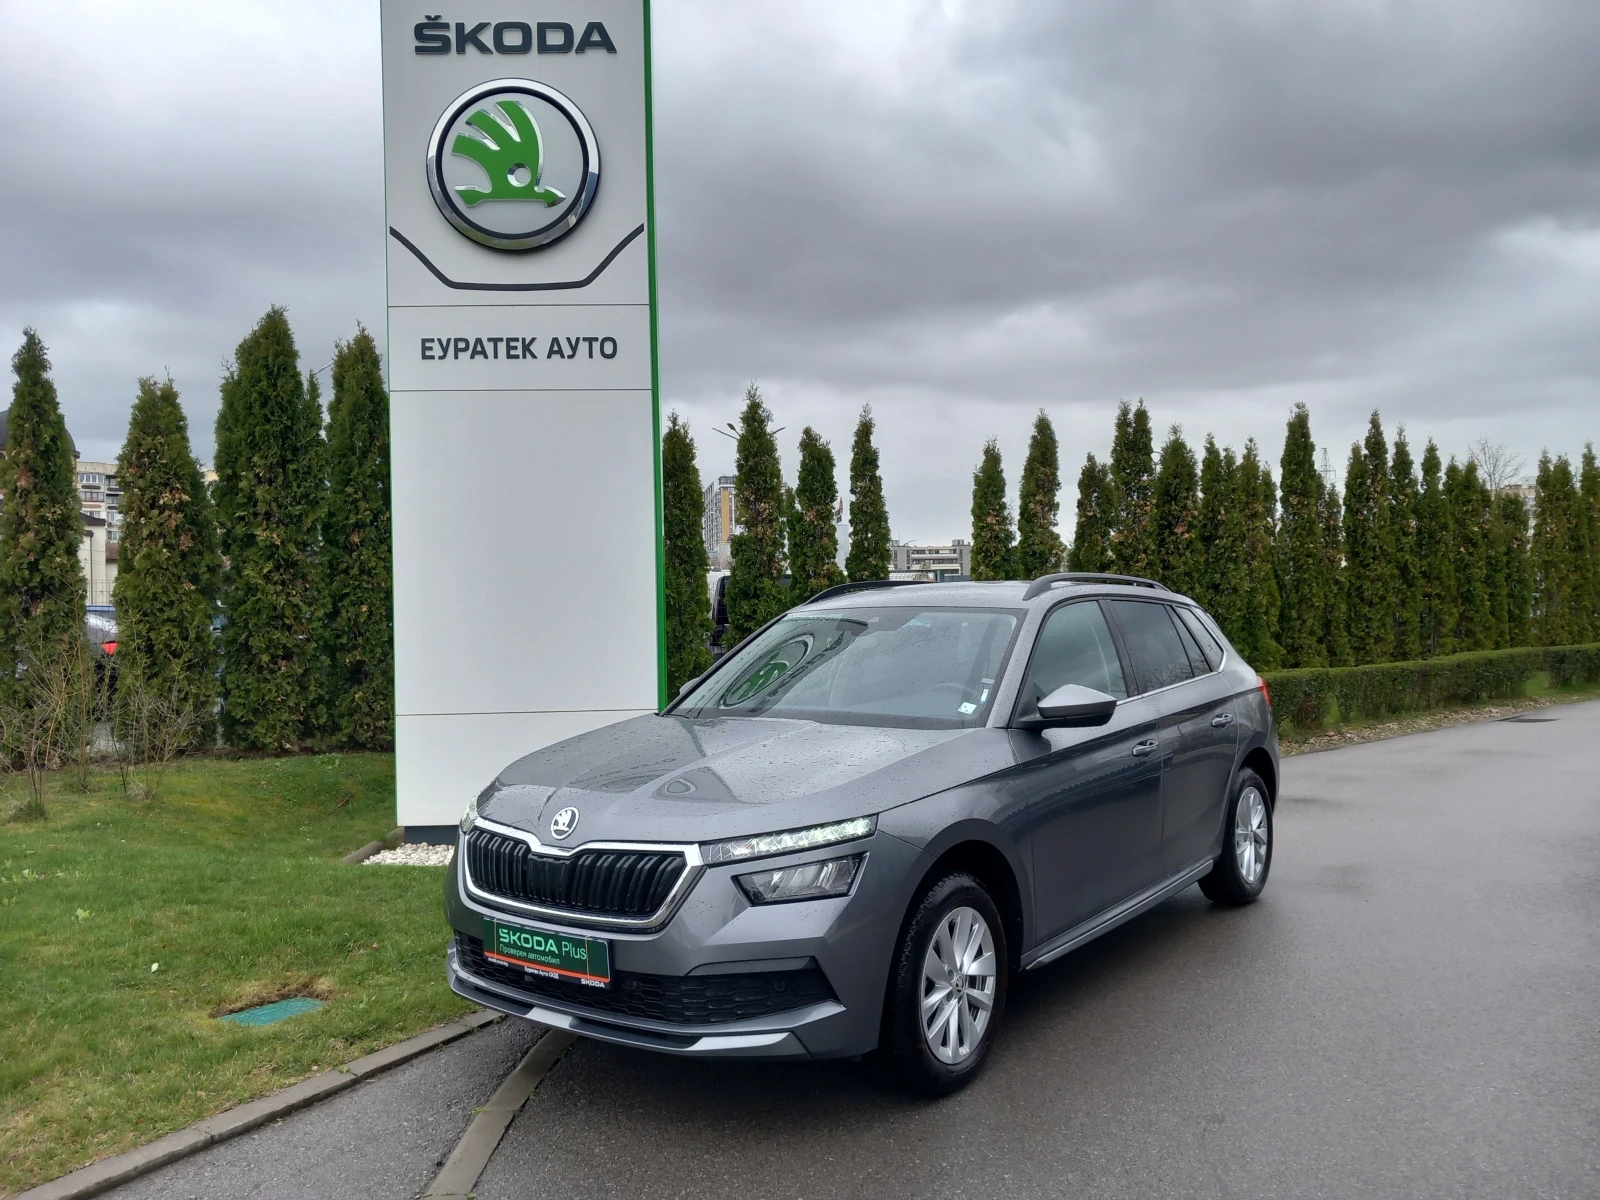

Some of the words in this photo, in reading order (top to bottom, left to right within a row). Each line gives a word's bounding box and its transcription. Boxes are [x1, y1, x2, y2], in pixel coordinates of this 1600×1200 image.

[414, 15, 618, 55] ŠKODA
[420, 336, 538, 361] ЕУРАТЕК
[546, 336, 618, 360] АУТО
[500, 944, 527, 959] Проверен
[528, 951, 560, 965] автомобил
[562, 941, 587, 960] Plus
